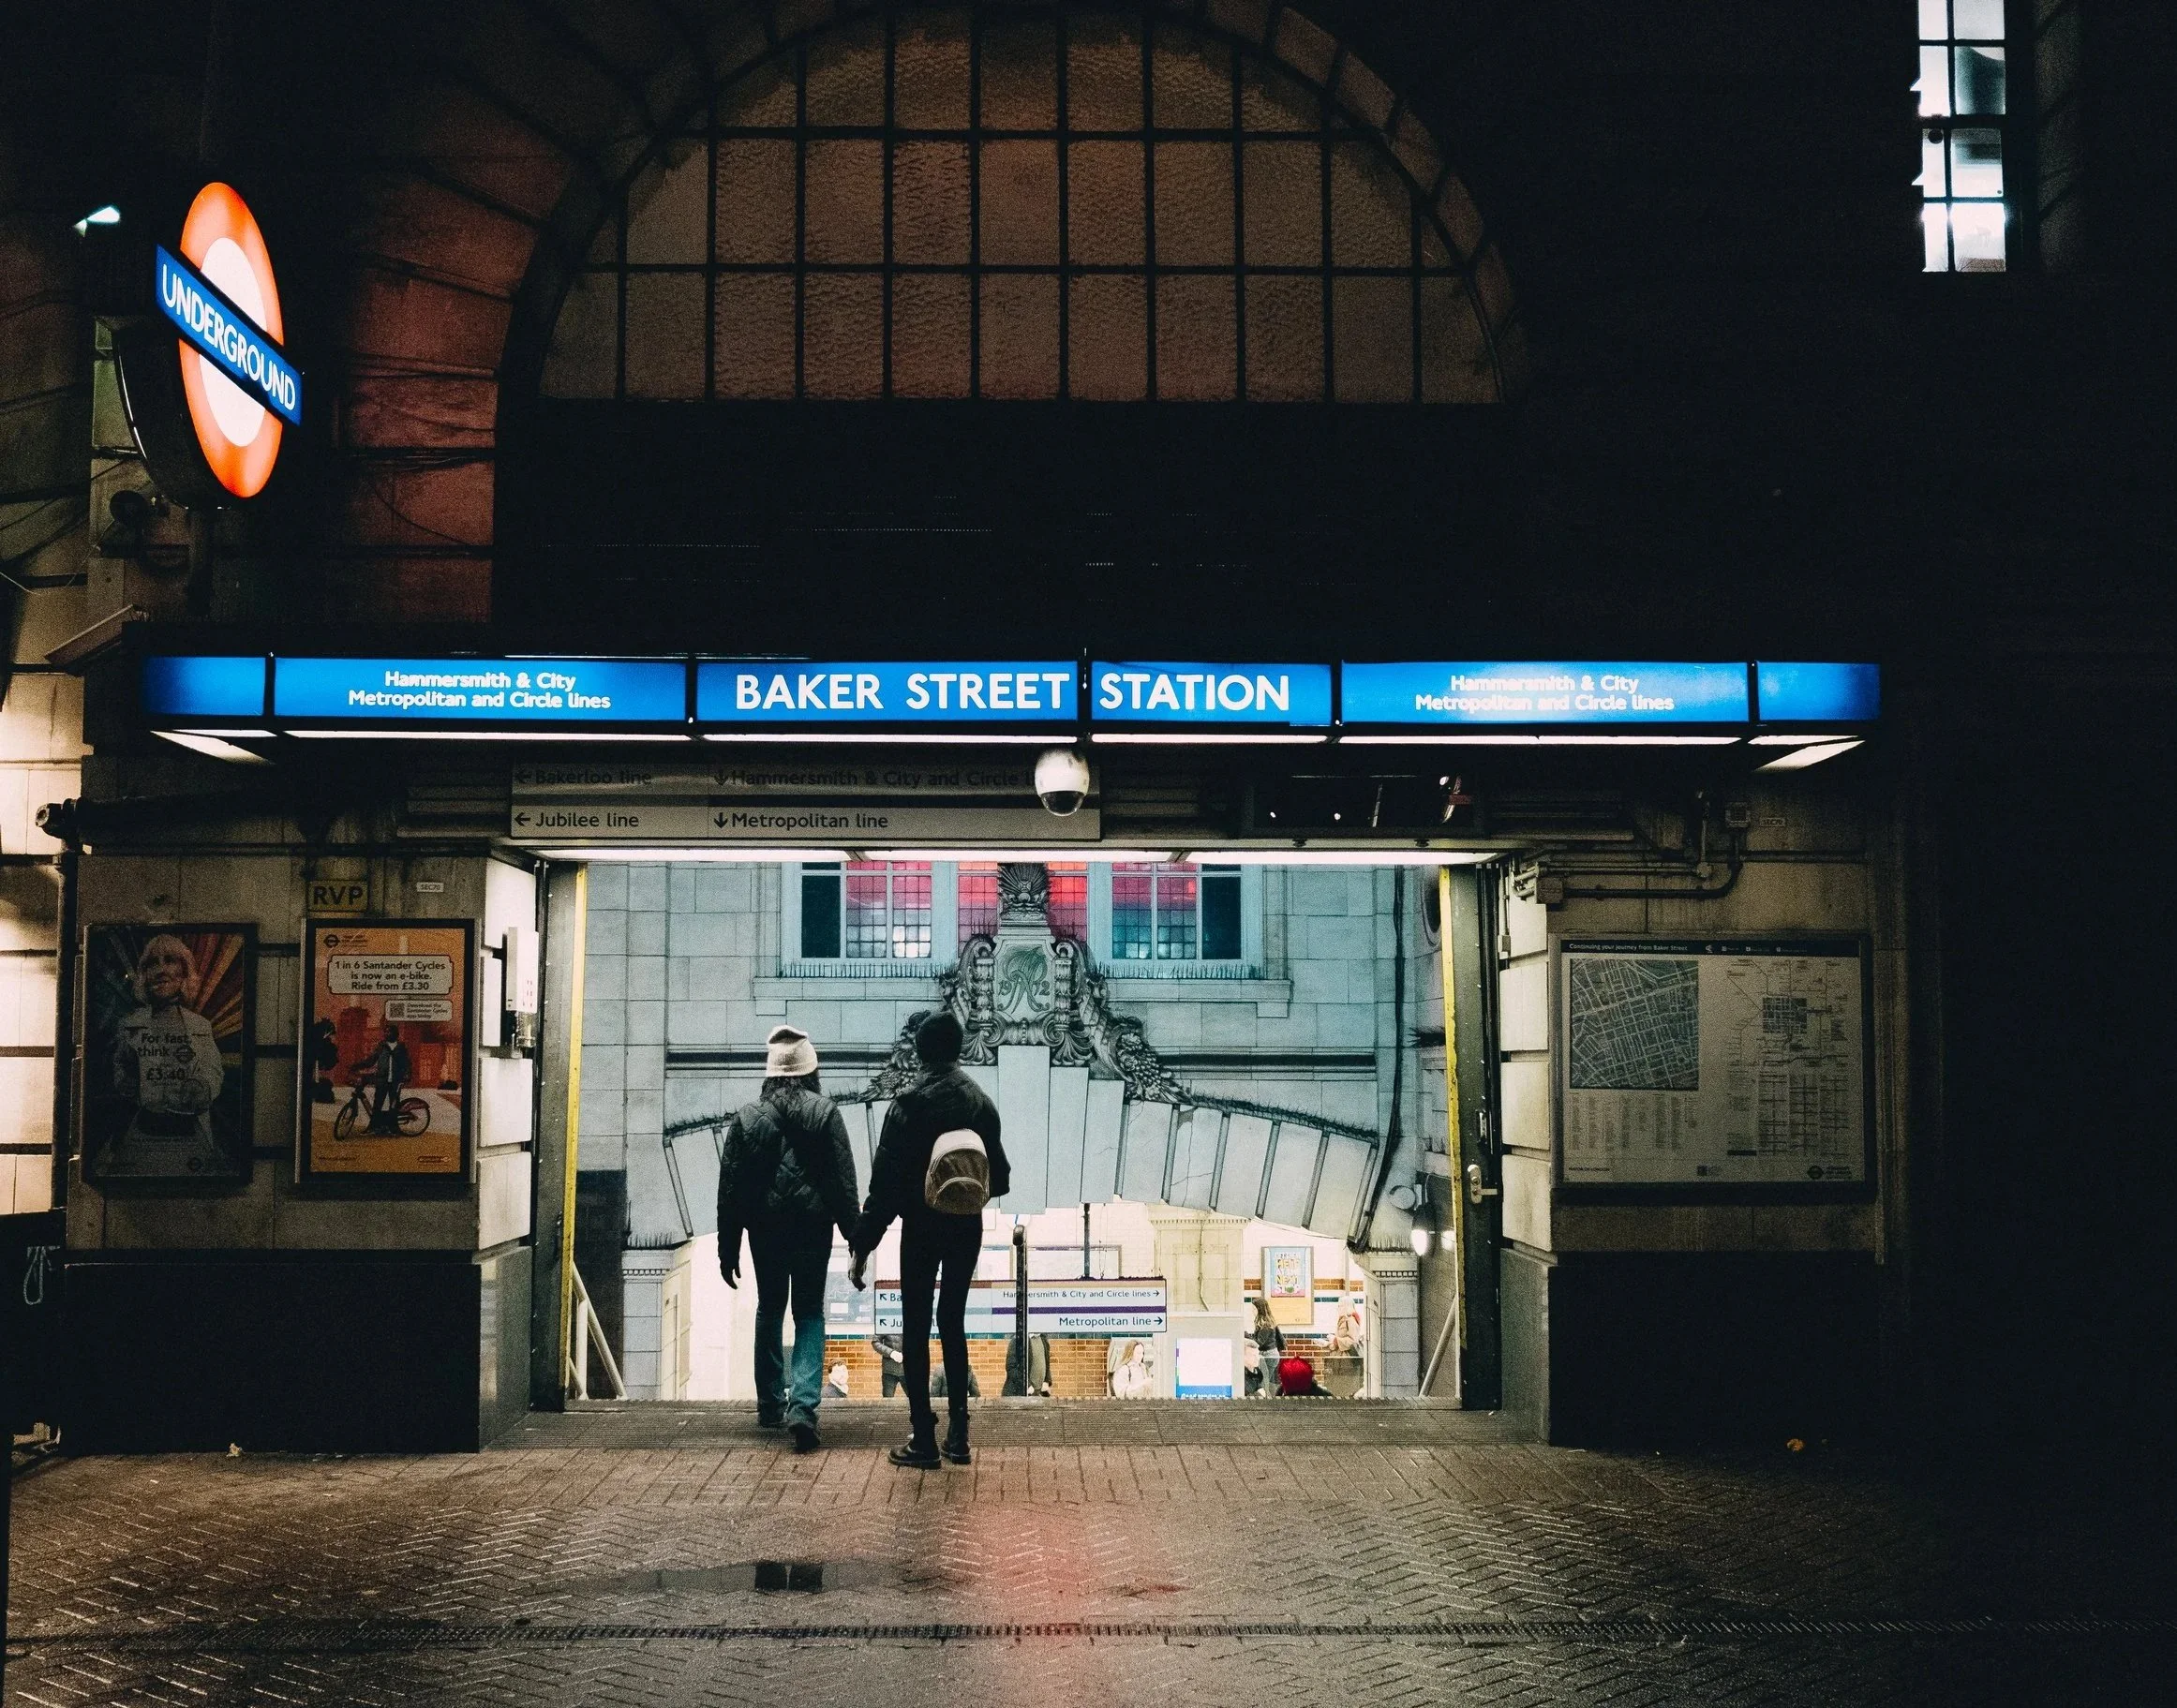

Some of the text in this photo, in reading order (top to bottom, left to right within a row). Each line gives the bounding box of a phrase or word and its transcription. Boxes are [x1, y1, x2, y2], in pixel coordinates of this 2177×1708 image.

[162, 263, 296, 411] UNDERGROUND
[385, 670, 576, 692] Hammersmith & City
[1450, 675, 1640, 694] Hammersmith & City
[348, 690, 611, 709] Metropolitan and Circle lines
[736, 673, 1290, 711] BAKER STREET STATION
[1415, 694, 1675, 714] Metropolitan and Circle lines
[535, 770, 651, 785] Bakerloo line
[731, 770, 857, 785] Hammersmith
[865, 771, 878, 785] &
[884, 771, 919, 789] City
[928, 771, 961, 785] and
[967, 771, 1019, 786] Circle
[535, 812, 639, 827] Jubilee line
[731, 812, 888, 830] Metropolitan line
[314, 885, 364, 905] RVP
[363, 961, 412, 970] Santander
[415, 961, 446, 972] Cycles
[350, 972, 359, 980] is
[399, 972, 432, 980] e-bike.
[351, 981, 429, 990] Ride from £3.30
[141, 1032, 160, 1043] For
[138, 1045, 170, 1057] think
[146, 1068, 186, 1080] £3.40
[1069, 1290, 1087, 1300] City
[1059, 1316, 1152, 1329] Metropolitan line
